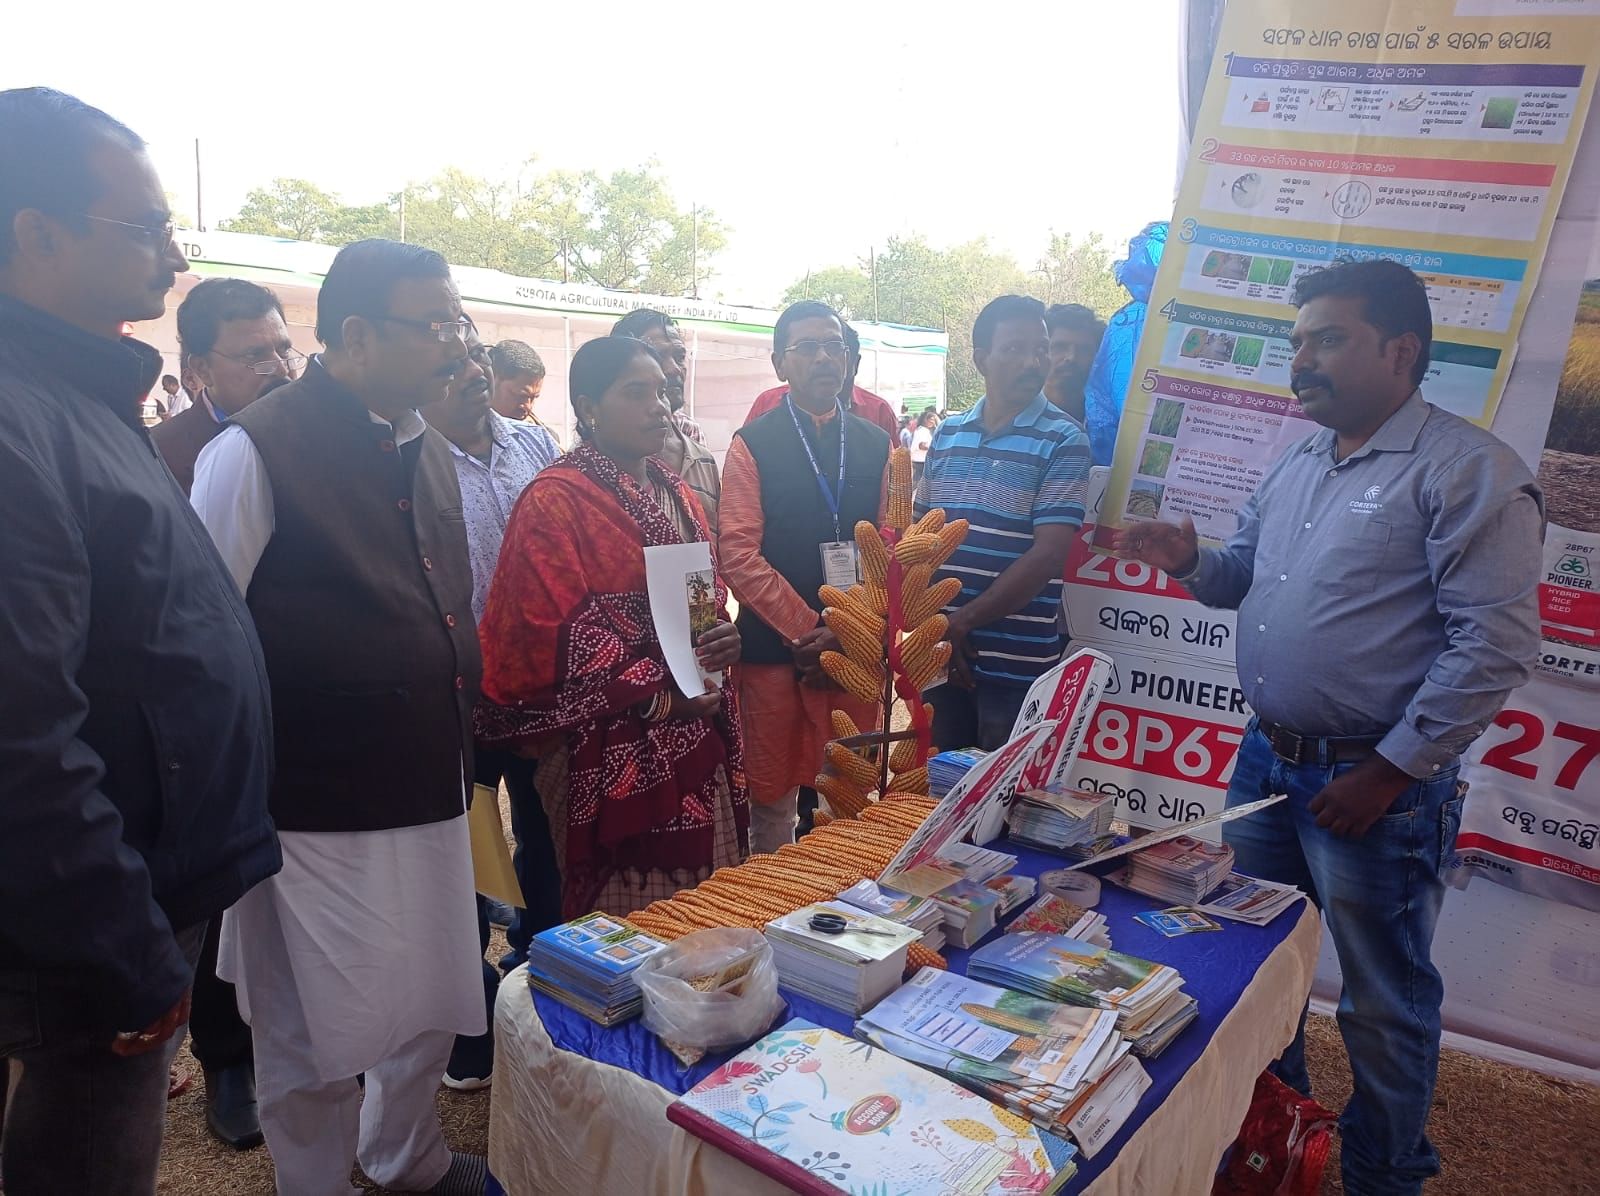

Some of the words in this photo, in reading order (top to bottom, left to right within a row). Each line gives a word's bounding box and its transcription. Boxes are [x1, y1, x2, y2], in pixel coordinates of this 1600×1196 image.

[1263, 28, 1306, 46] ସଫଳ
[1308, 30, 1343, 47] ଧାନ
[1346, 31, 1381, 49] ଚାଷ
[1385, 25, 1426, 50] ପାଇଁ
[1447, 31, 1494, 50] ସରଳ
[1497, 31, 1553, 50] ଉପାୟ
[515, 285, 557, 304] KUBOTA
[560, 291, 632, 311] AGRICULTURAL
[683, 306, 706, 319] INDIA
[708, 308, 723, 320] PVT
[725, 308, 739, 322] LTD
[1141, 368, 1159, 393] 5
[1565, 542, 1595, 555] 28P67
[1547, 572, 1593, 590] PIONEER
[1547, 588, 1581, 600] HYBRID
[1551, 596, 1573, 606] RICE
[1547, 603, 1571, 614] SEED
[1181, 617, 1229, 648] ଧାନ
[1130, 670, 1246, 715] PIONEER
[1054, 714, 1087, 781] PIONEER
[1079, 709, 1243, 783] 8P67
[1502, 805, 1536, 835] ସବୁ
[1542, 818, 1600, 851] ପରିସ୍ଥି
[1464, 855, 1514, 875] CORTEVA
[742, 1043, 817, 1096] SWADESH
[854, 1099, 884, 1126] ACCOUNT
[869, 1111, 890, 1127] BOOK
